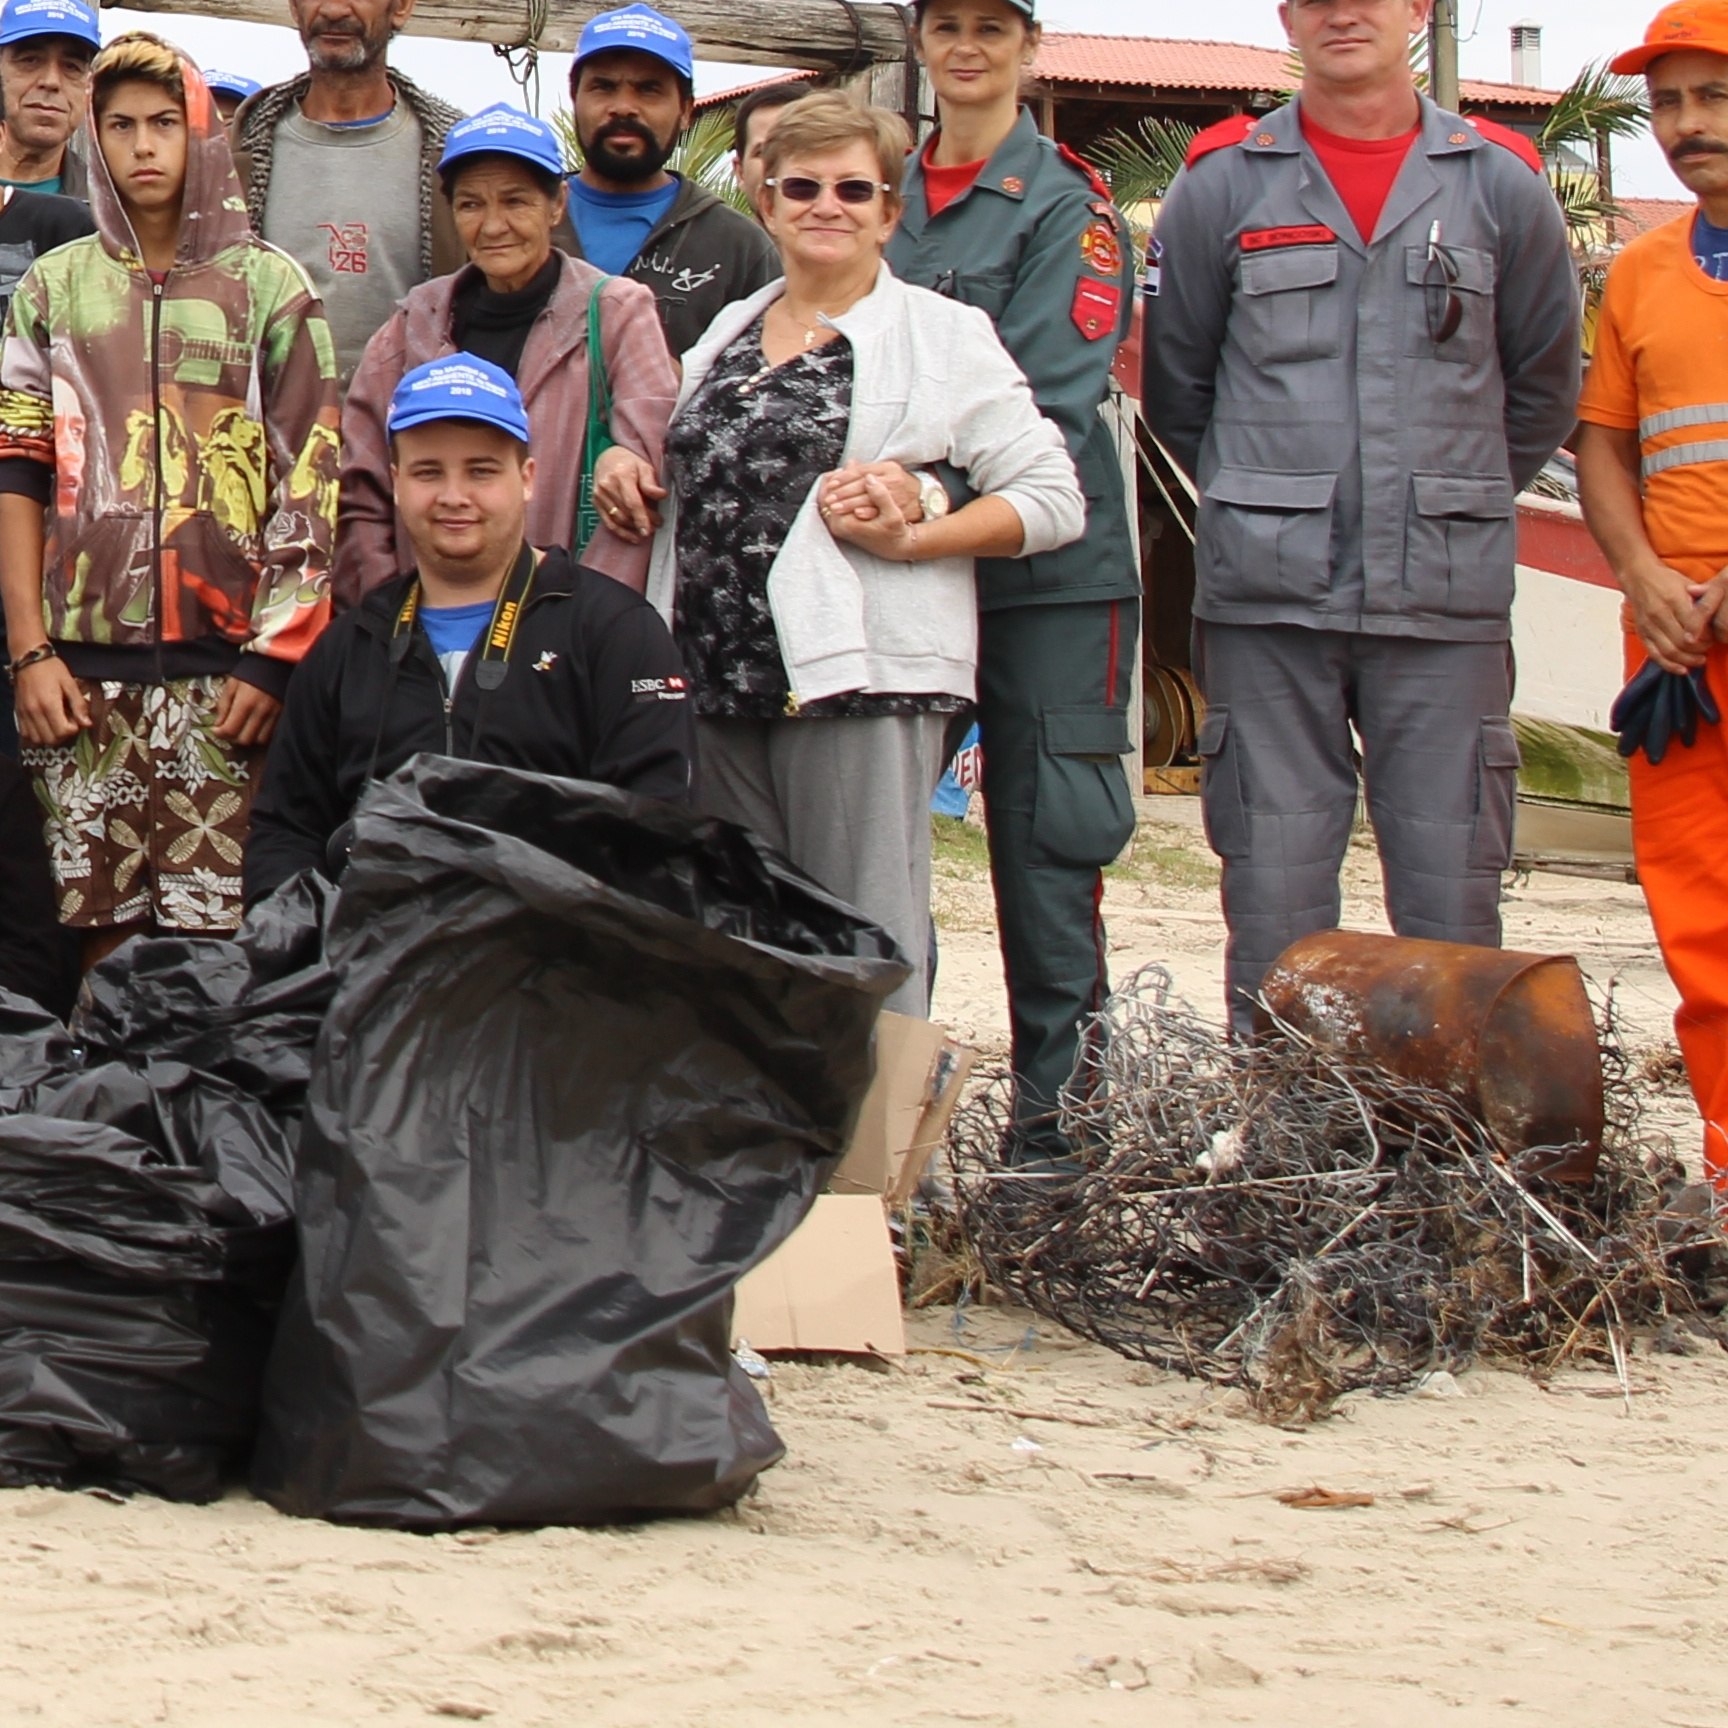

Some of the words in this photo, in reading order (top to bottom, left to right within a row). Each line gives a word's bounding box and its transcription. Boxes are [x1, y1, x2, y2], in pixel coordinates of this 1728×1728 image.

[335, 251, 367, 273] 26
[491, 601, 518, 649] Nikon
[630, 678, 666, 693] HSBC
